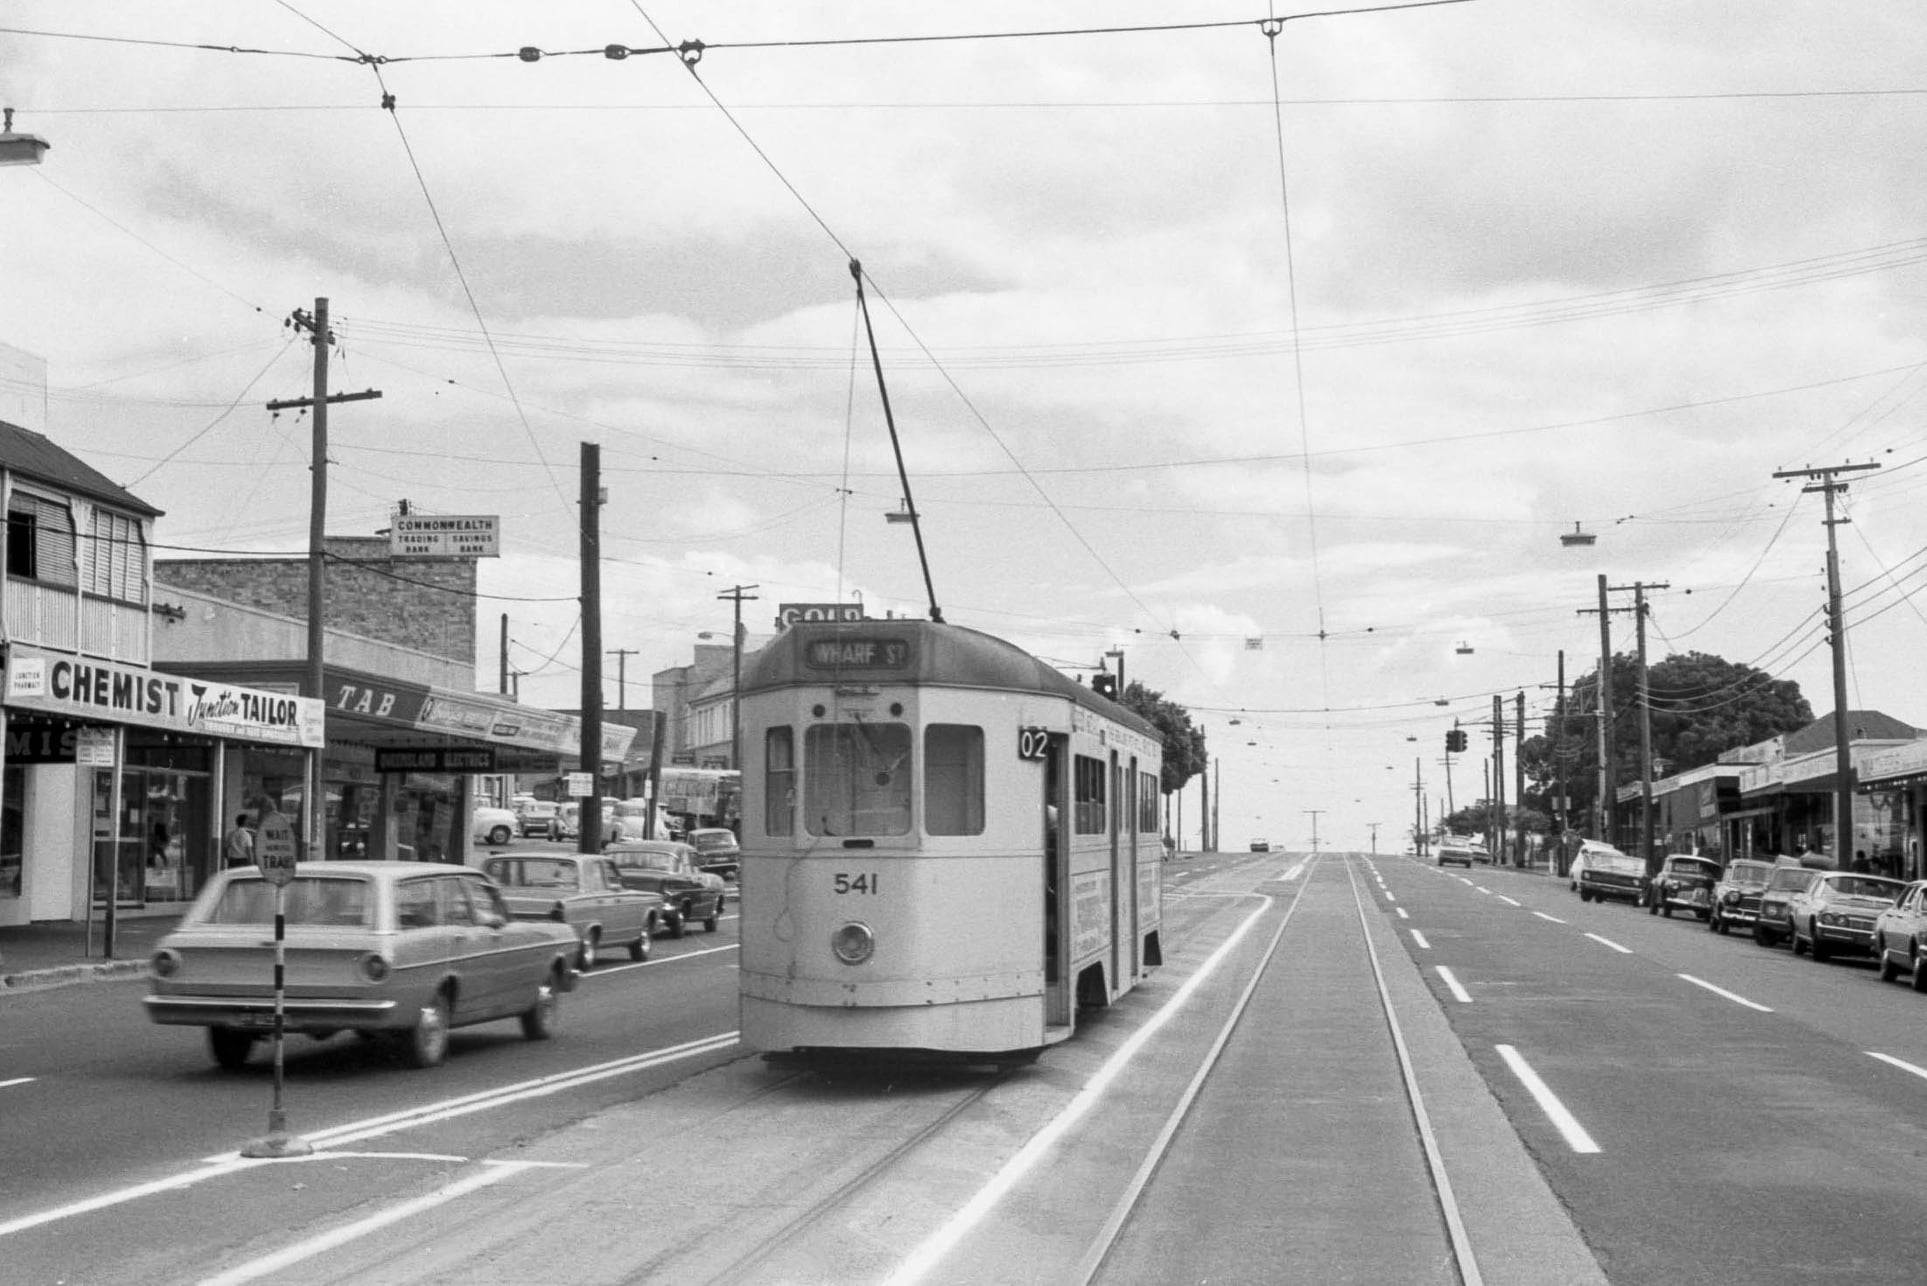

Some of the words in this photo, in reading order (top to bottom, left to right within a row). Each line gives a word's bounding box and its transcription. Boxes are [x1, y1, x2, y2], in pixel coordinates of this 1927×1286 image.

[398, 519, 493, 531] COMMONWEALTH
[398, 534, 440, 543] TRADING
[405, 545, 430, 553] BANK
[453, 534, 493, 543] SAVINGS
[459, 545, 485, 553] BANK
[813, 643, 875, 664] WHARF
[51, 660, 179, 716] CHEMIST
[188, 683, 240, 727] Junction
[241, 693, 298, 726] TAILOR
[337, 684, 396, 717] TAB
[1022, 731, 1048, 757] 02
[834, 873, 877, 895] 541
